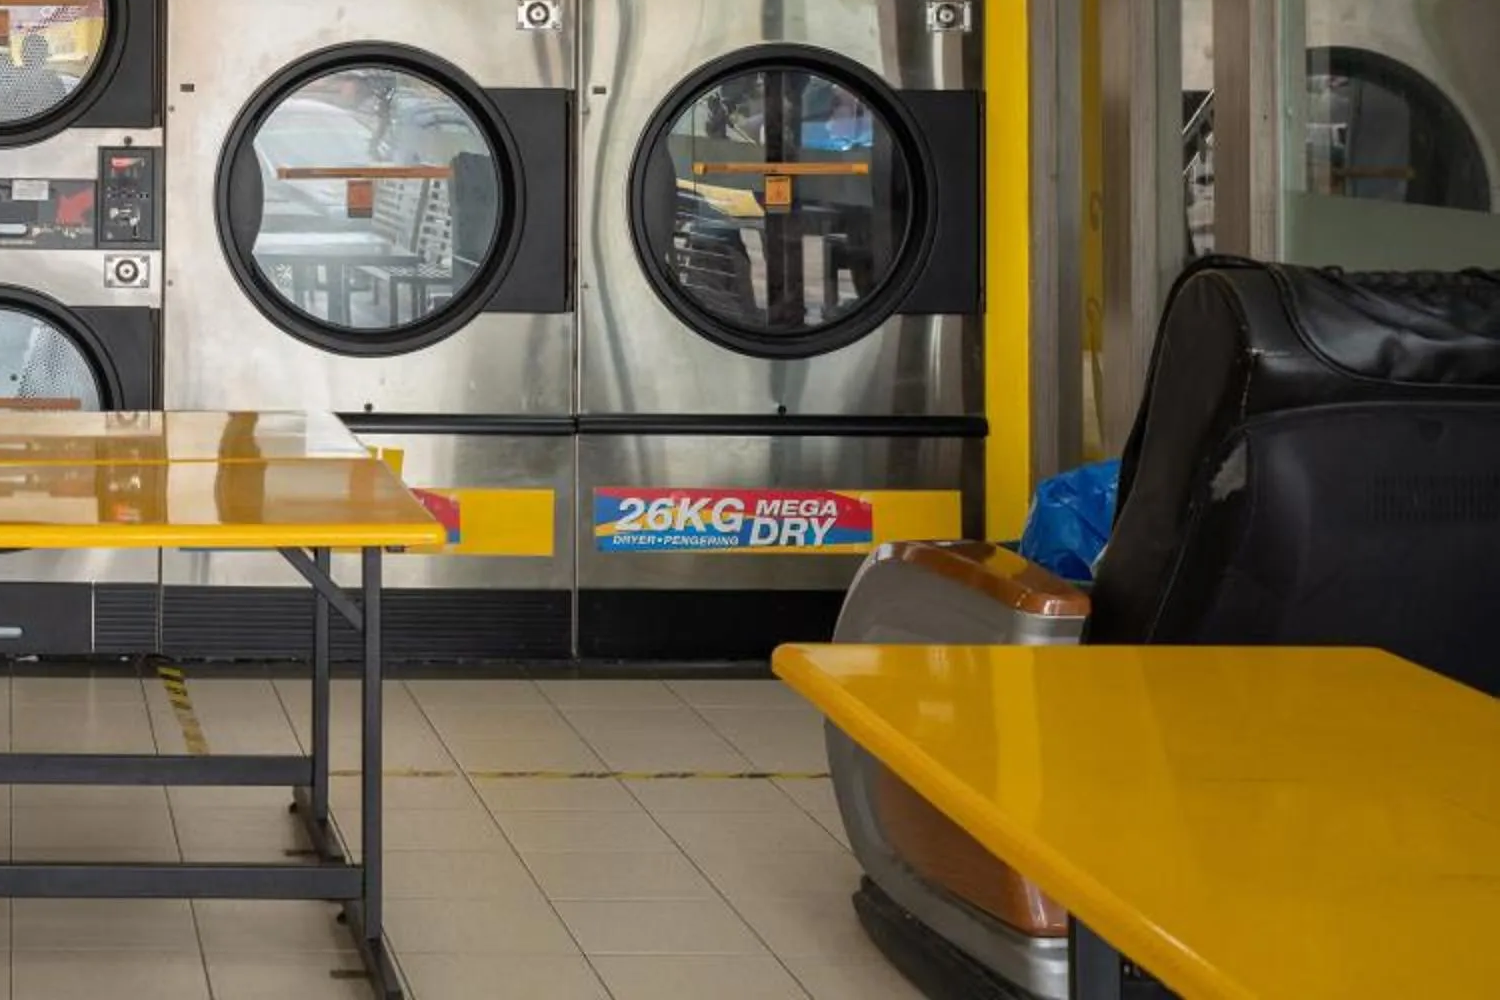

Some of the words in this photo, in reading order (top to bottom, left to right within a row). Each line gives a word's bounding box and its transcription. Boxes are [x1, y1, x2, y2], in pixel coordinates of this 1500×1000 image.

[615, 497, 745, 534] 26KG
[755, 499, 839, 518] MEGA
[749, 517, 837, 550] DRY
